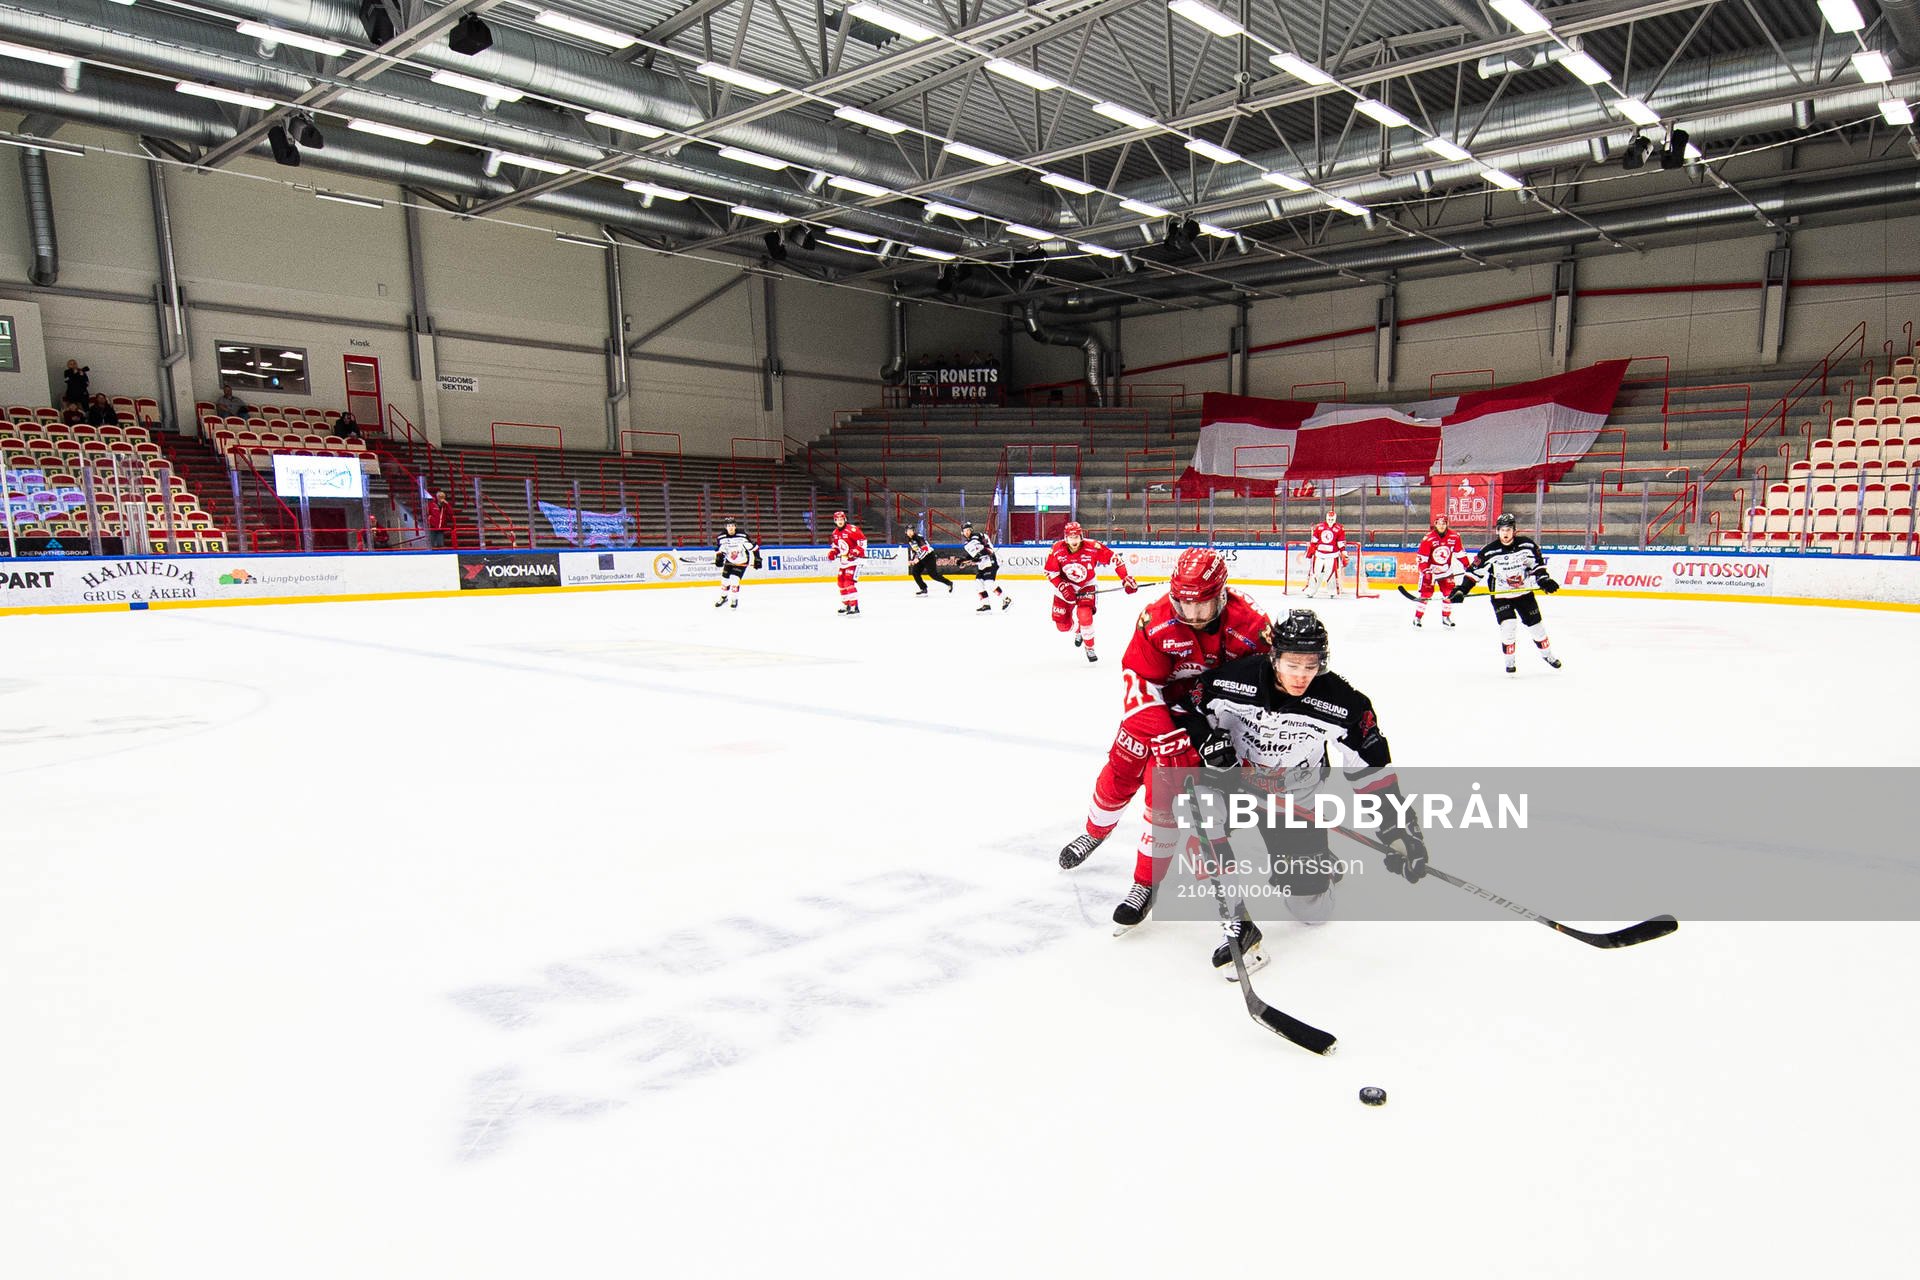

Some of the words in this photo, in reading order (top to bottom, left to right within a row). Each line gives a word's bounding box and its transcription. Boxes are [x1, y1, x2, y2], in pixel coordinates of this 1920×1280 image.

[350, 339, 370, 347] Kiosk
[940, 368, 998, 383] RONETTS
[442, 383, 473, 392] SEKTION
[952, 386, 986, 398] BYGG
[1449, 497, 1486, 514] RED
[82, 561, 194, 588] HAMNEDA
[486, 564, 557, 577] YOKOHAMA
[1673, 562, 1769, 578] OTTOSSON
[1606, 575, 1662, 587] TRONIC
[84, 590, 126, 601] GRUS
[132, 590, 142, 600] &
[149, 586, 196, 599] ÅKERI
[1117, 730, 1144, 757] EAB
